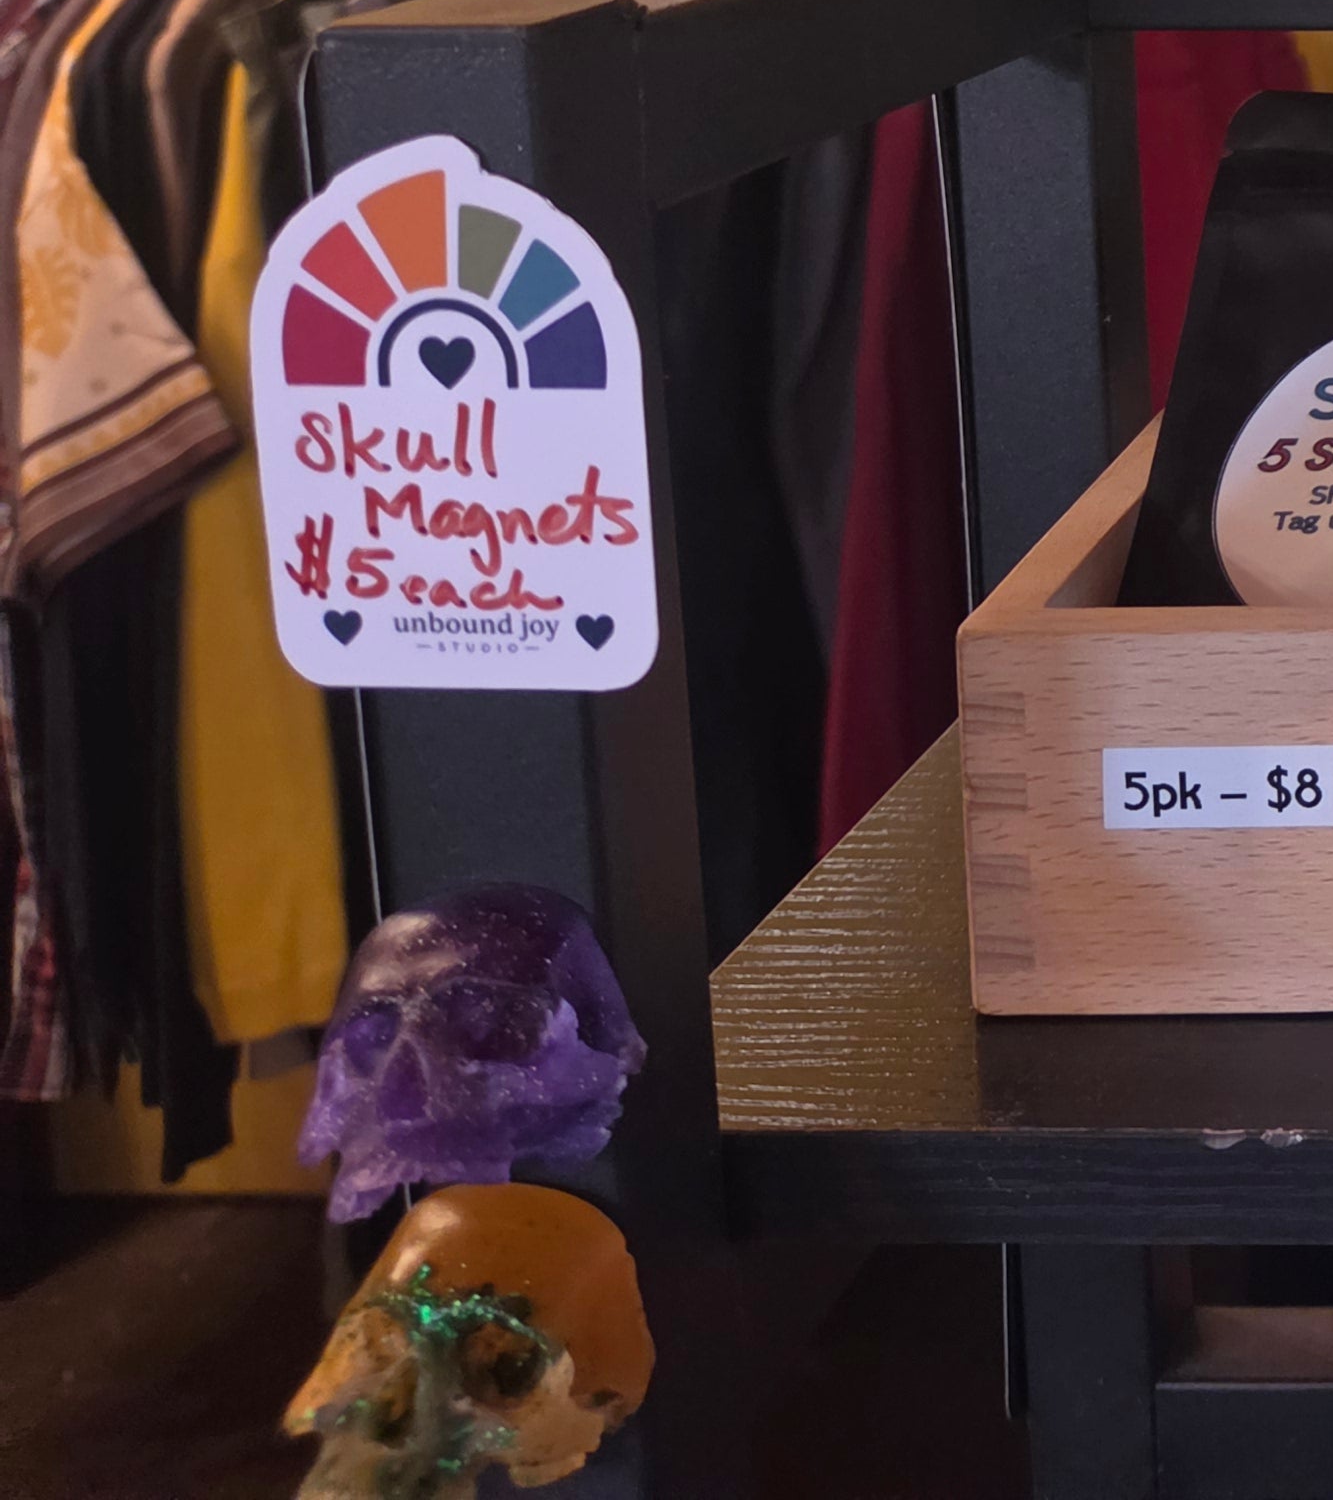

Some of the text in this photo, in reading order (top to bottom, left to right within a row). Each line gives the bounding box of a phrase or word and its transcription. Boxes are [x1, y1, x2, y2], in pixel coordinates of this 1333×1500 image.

[295, 397, 497, 478] Skull
[1257, 438, 1299, 473] 5
[363, 465, 640, 577] Magnets
[1274, 511, 1321, 534] Tag
[399, 568, 564, 611] each
[393, 611, 560, 642] unbound joy
[438, 641, 518, 653] STUDIO
[1124, 771, 1202, 817] 5pk
[1267, 765, 1323, 812] $8
